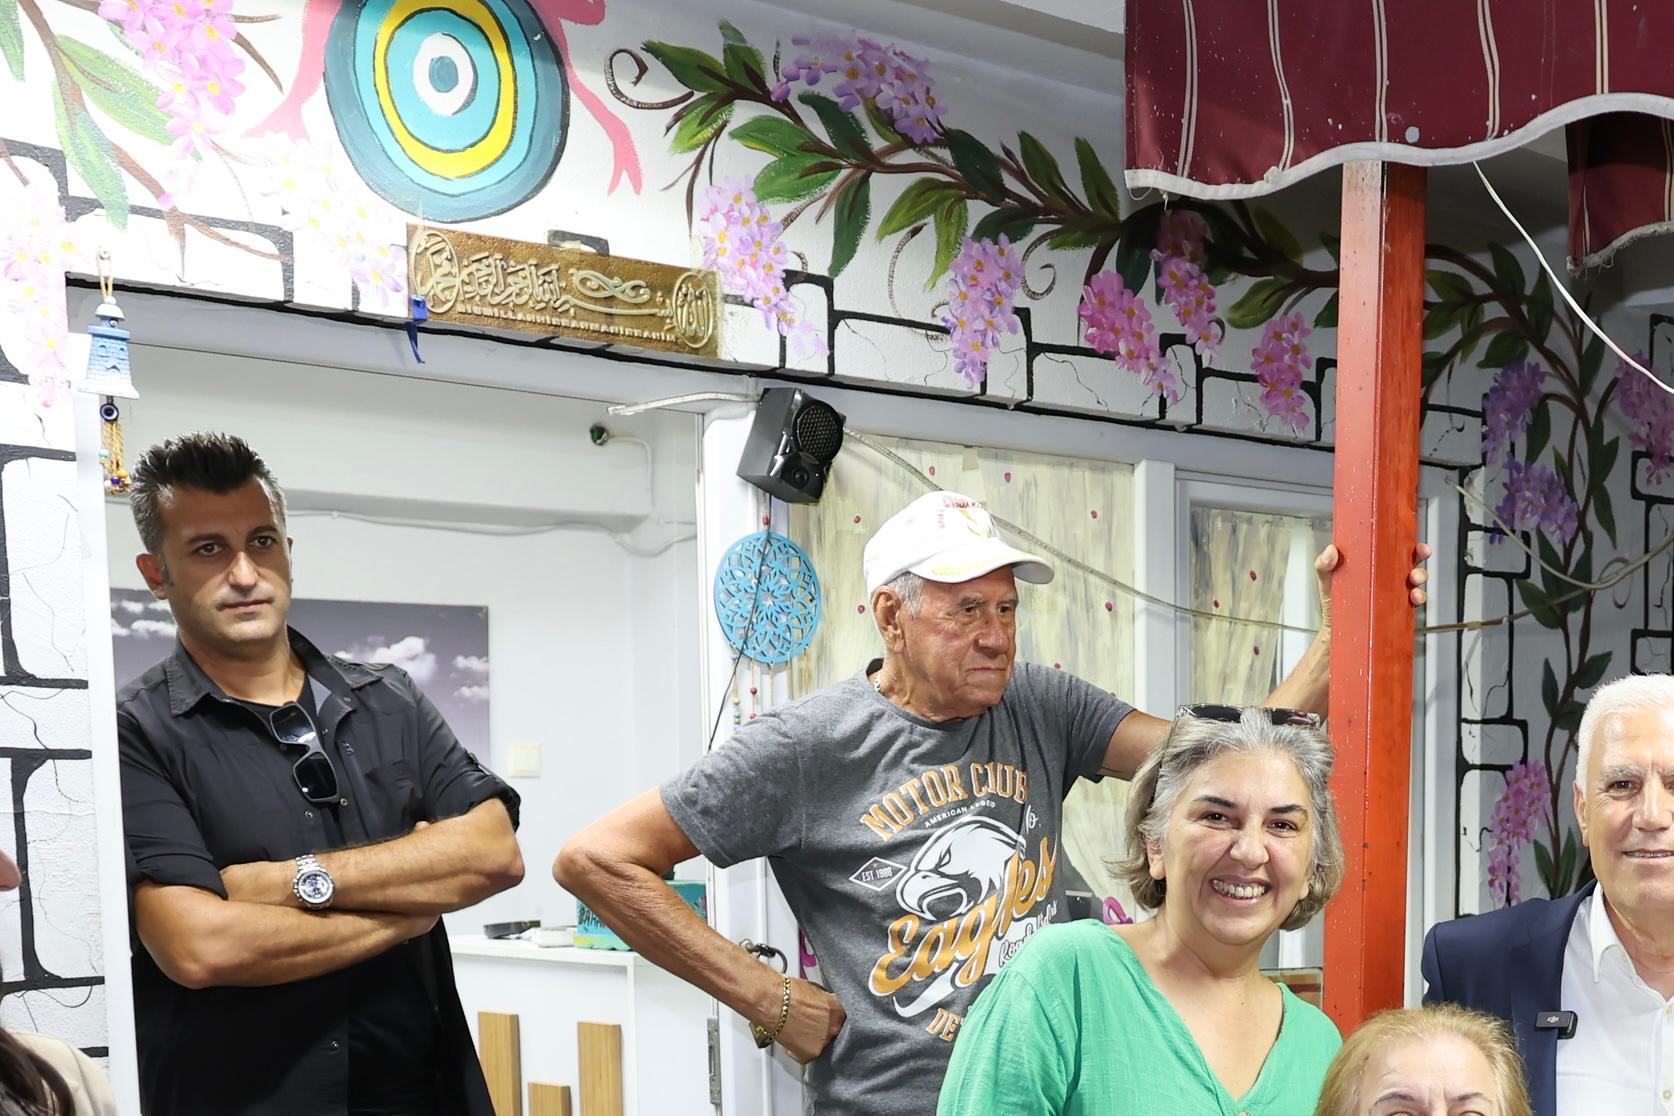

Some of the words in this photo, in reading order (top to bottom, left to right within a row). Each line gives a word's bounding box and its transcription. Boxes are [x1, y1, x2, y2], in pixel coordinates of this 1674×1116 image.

[859, 764, 969, 842] MOTOR
[924, 806, 968, 828] AMERICAN
[868, 834, 1057, 998] Eagles
